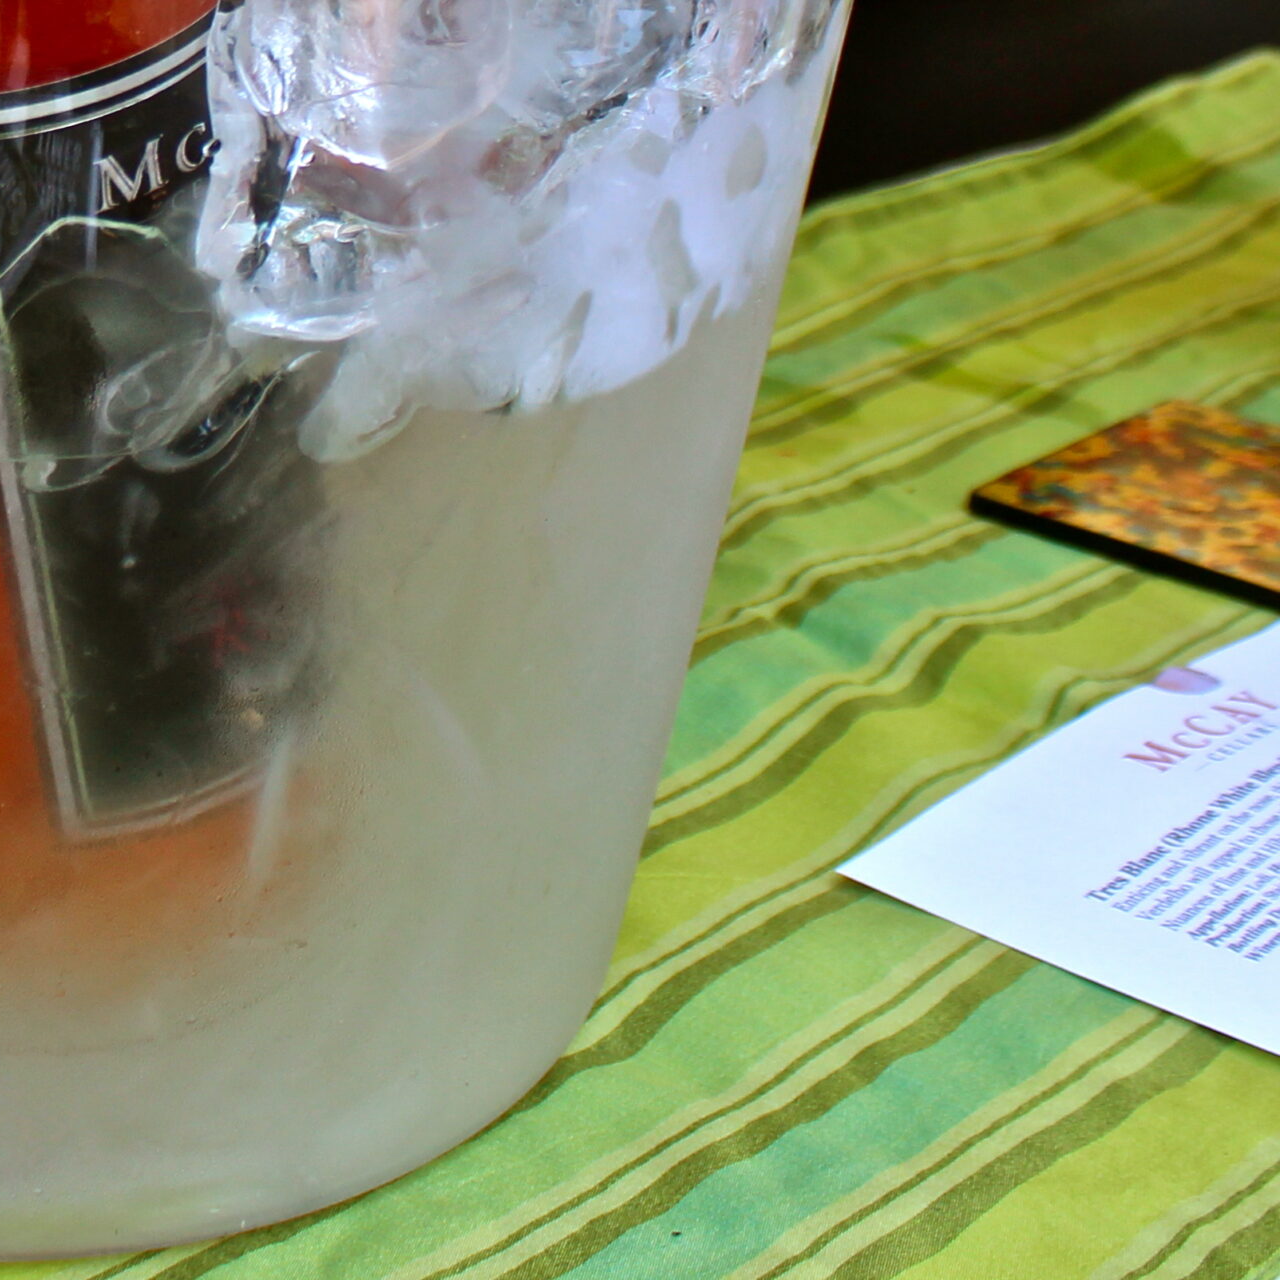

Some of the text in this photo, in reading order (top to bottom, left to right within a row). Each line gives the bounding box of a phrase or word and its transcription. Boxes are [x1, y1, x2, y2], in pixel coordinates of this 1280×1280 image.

[1083, 875, 1131, 903] Tres
[1118, 844, 1172, 878] Blanc
[1160, 808, 1222, 848] (Rhone
[1207, 780, 1261, 810] White
[1111, 876, 1171, 913] Enticing
[1160, 858, 1189, 879] and
[1179, 833, 1226, 863] vibrant
[1218, 823, 1240, 837] on
[1229, 811, 1255, 826] the
[1134, 883, 1195, 922] Verdelho
[1186, 865, 1216, 885] will
[1208, 842, 1249, 871] appeal
[1238, 833, 1261, 846] to
[1159, 851, 1272, 932] Nuances of lime and
[1186, 889, 1255, 941] Appellation:
[1204, 898, 1272, 948] Production:
